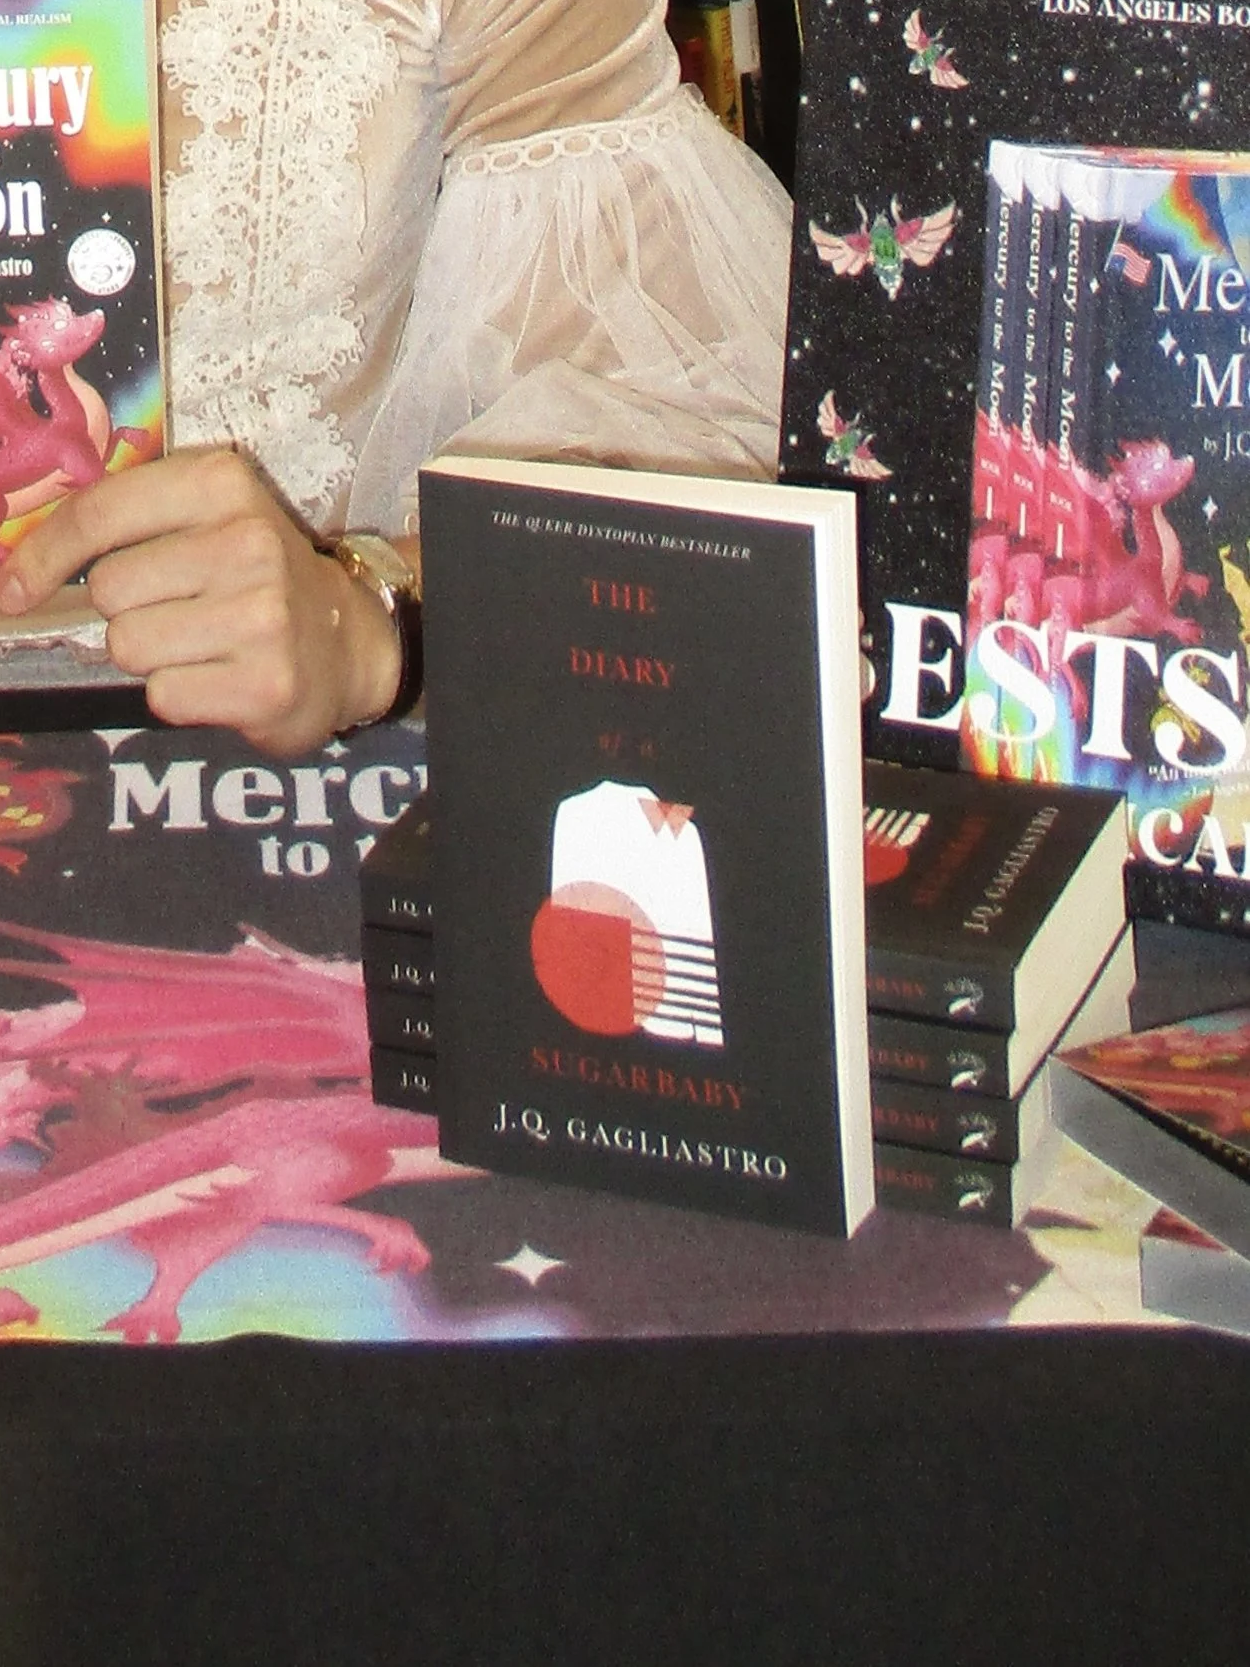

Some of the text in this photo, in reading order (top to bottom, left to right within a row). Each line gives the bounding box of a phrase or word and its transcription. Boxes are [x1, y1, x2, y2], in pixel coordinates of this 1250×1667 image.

[16, 13, 72, 26] REALISM
[491, 510, 750, 559] THE QUEER DYSTOPIAN BESTSELLER
[588, 579, 656, 612] THE
[569, 647, 676, 687] DIARY
[108, 761, 428, 831] Merc
[260, 835, 330, 878] to
[529, 1046, 746, 1111] SUGARBABY
[568, 1117, 787, 1180] GAGLIASTRO
